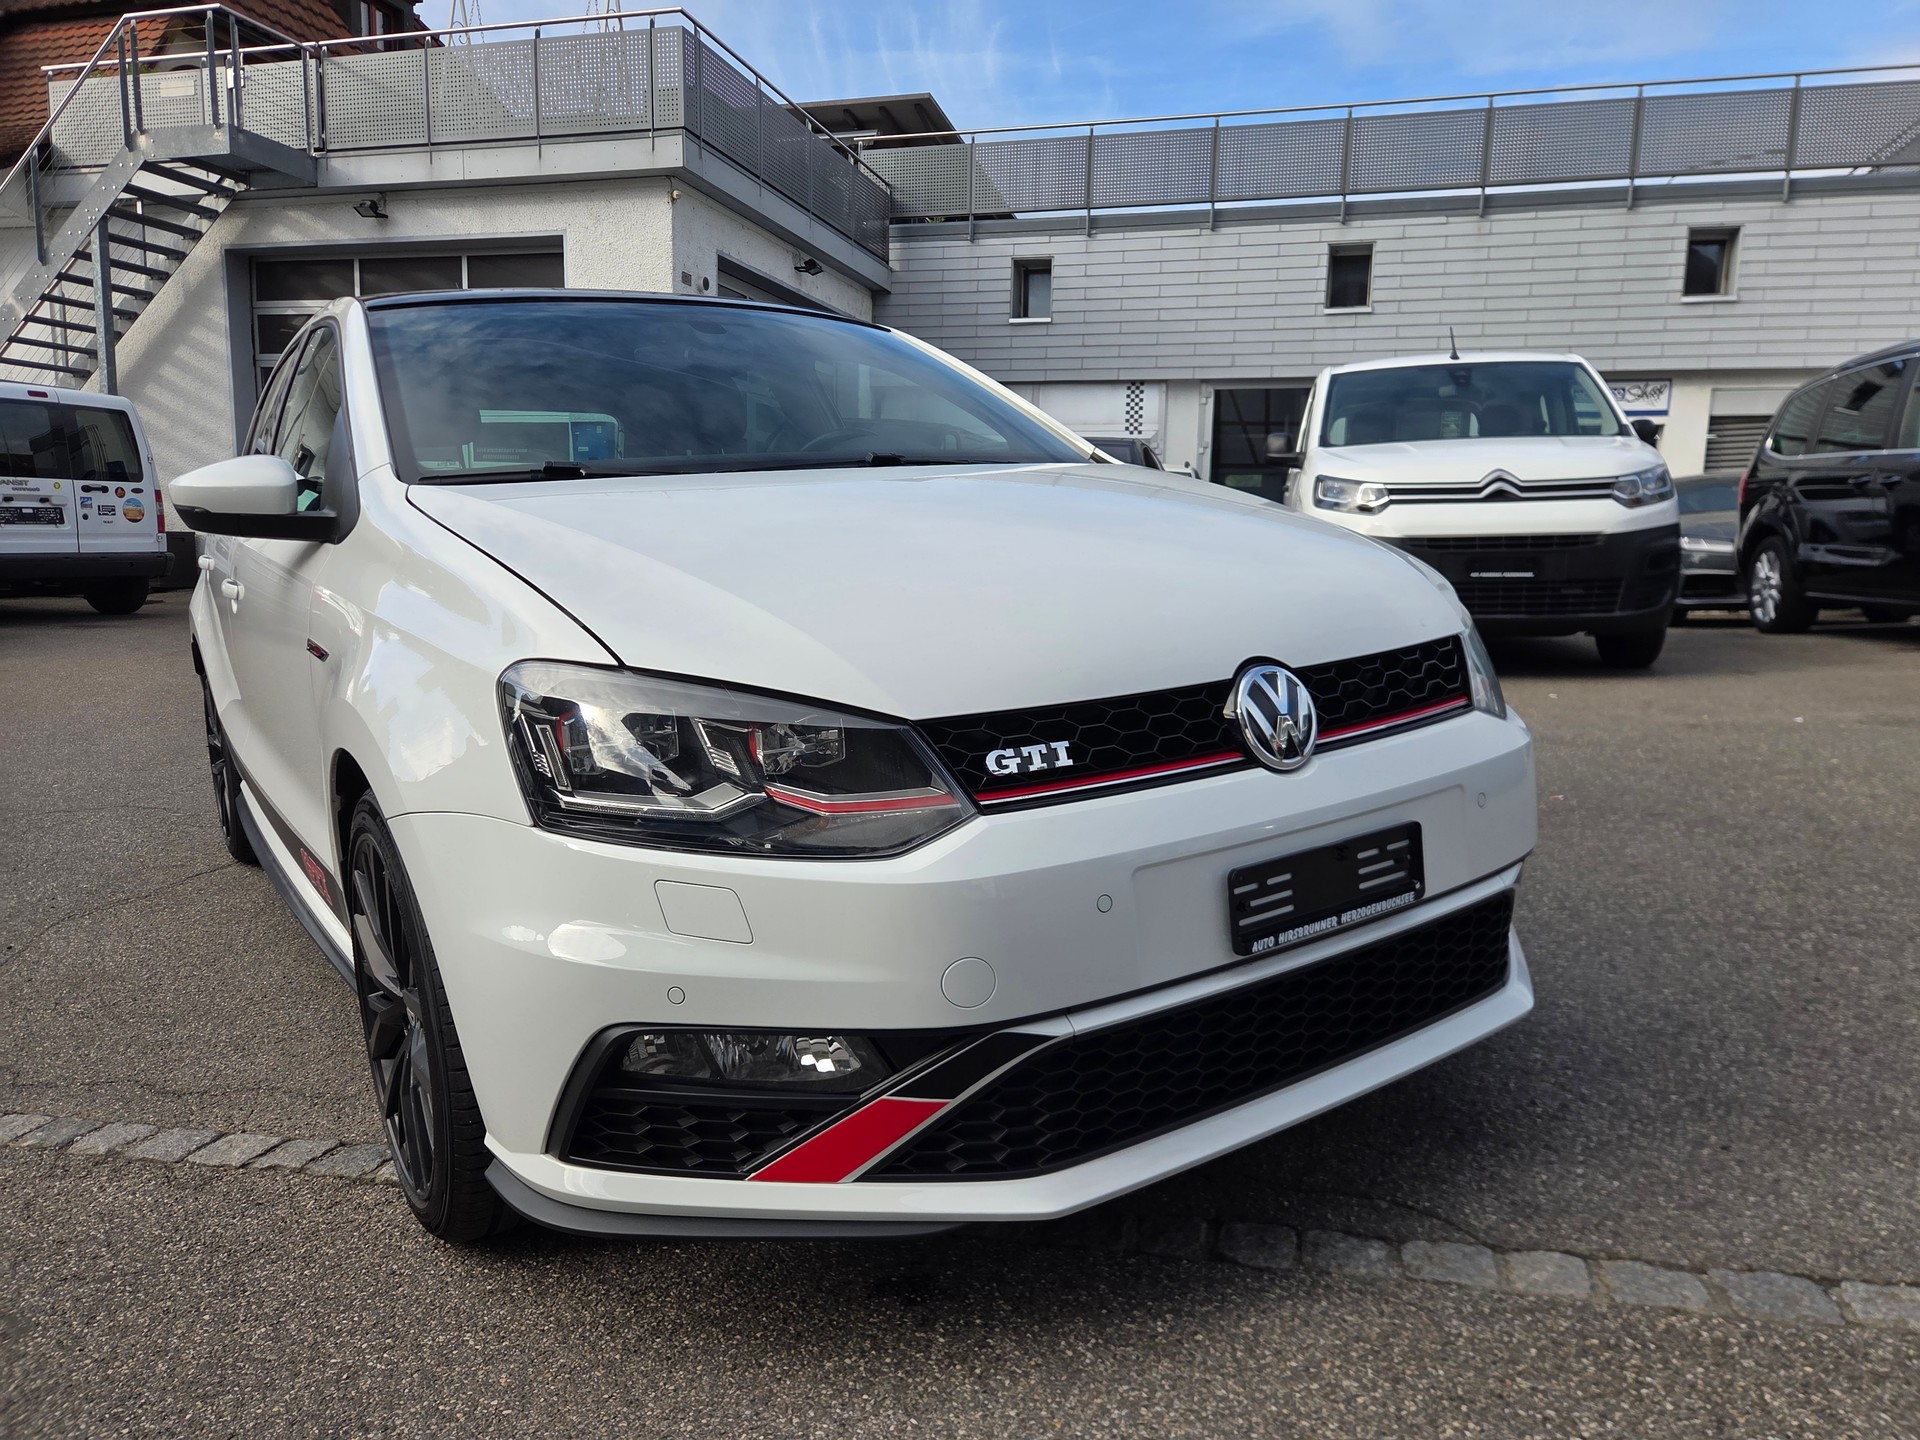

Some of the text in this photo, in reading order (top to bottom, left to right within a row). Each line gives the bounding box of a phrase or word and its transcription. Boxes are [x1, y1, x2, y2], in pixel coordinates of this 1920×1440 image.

[985, 741, 1074, 776] GTI
[1252, 891, 1415, 953] AUTO HIRSBRUNNER HERZOGENBUCHSEE
